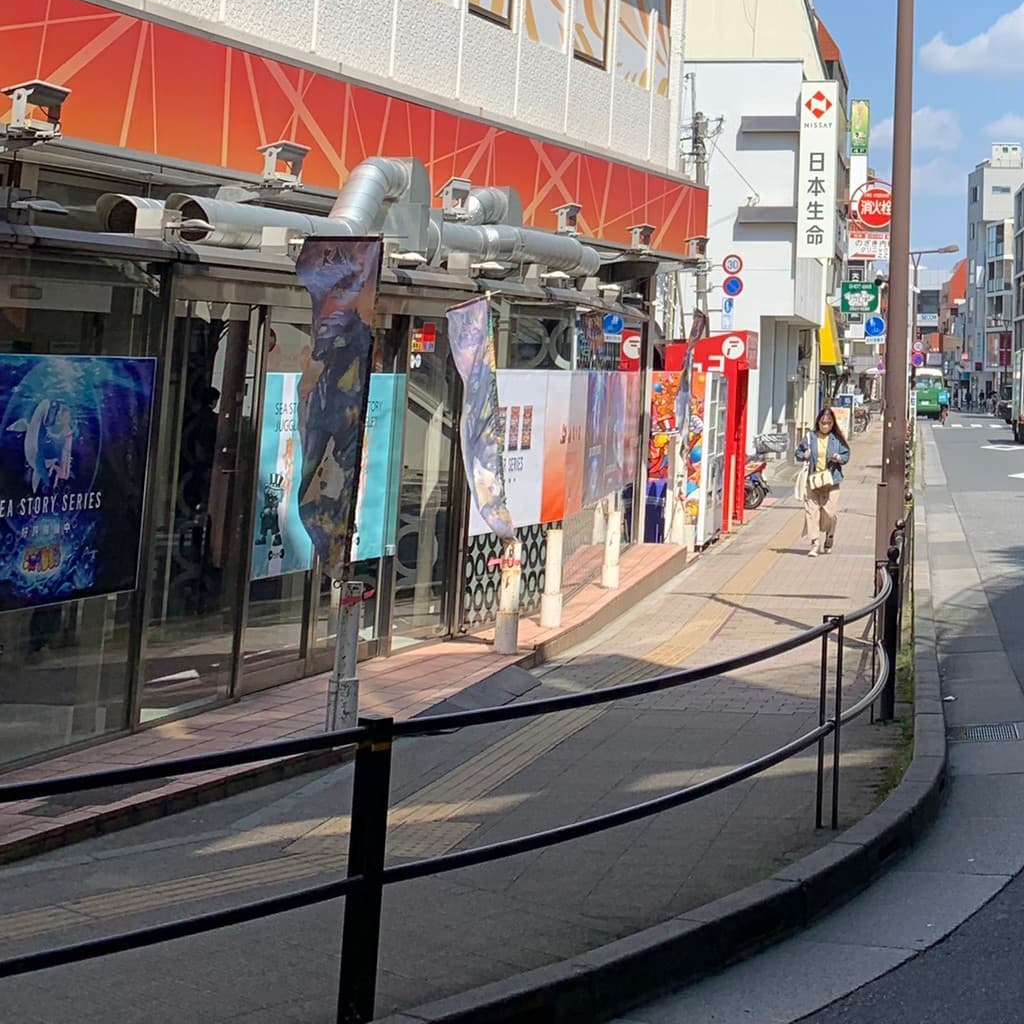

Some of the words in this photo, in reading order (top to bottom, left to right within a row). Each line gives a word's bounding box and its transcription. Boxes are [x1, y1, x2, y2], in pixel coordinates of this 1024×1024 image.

[806, 152, 826, 245] 日本生命
[861, 199, 891, 215] 消火栓
[727, 259, 739, 269] 30
[20, 495, 57, 516] STORY
[61, 492, 101, 511] SERIES
